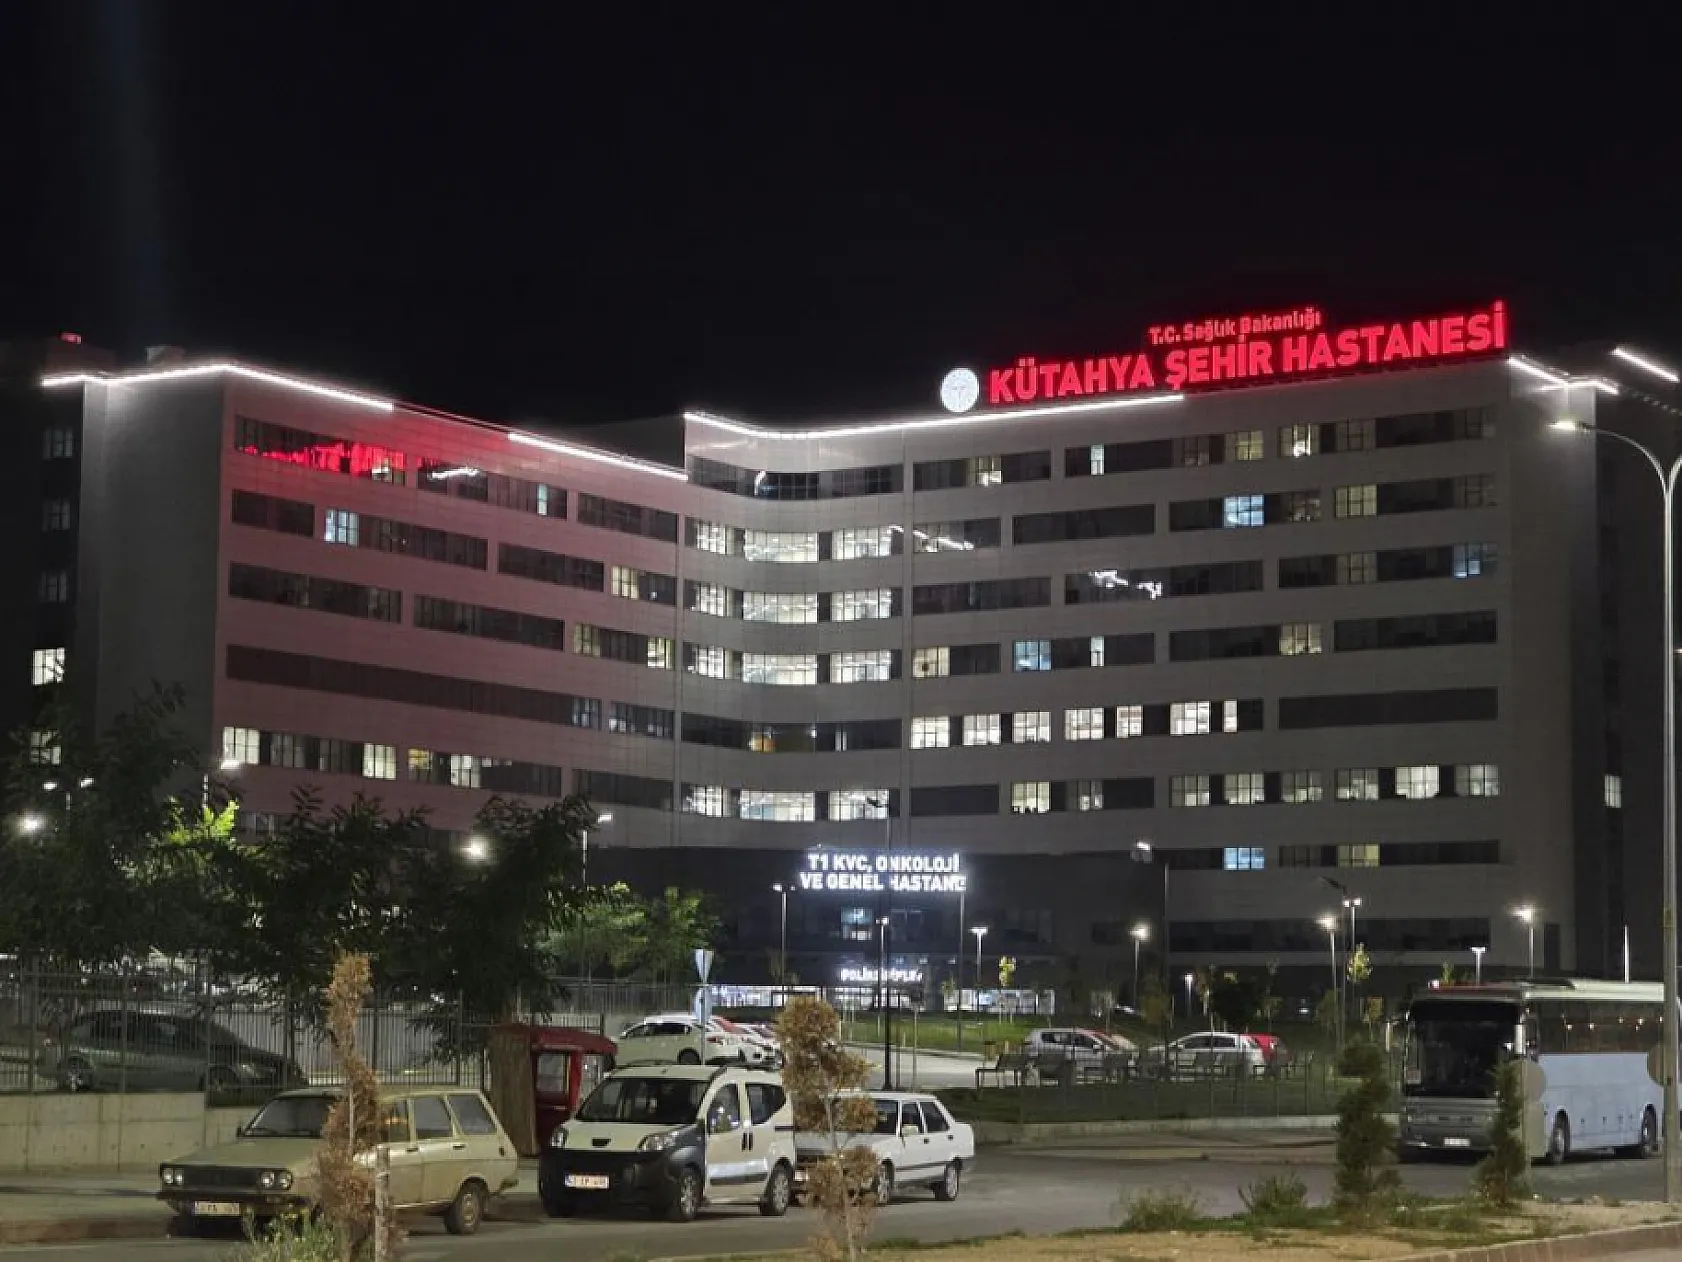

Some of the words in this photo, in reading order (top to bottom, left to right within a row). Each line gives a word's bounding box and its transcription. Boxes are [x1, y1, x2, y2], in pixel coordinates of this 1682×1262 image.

[1149, 325, 1180, 345] T.C.
[1183, 318, 1236, 342] Sağlık
[1240, 306, 1322, 335] Bakanlığı
[990, 356, 1154, 403] KÜTAHYA
[1166, 334, 1273, 390] ŞEHİR
[1282, 300, 1505, 373] HASTANESİ
[808, 853, 828, 871] T1
[800, 872, 823, 890] VE
[827, 873, 884, 891] GENEL
